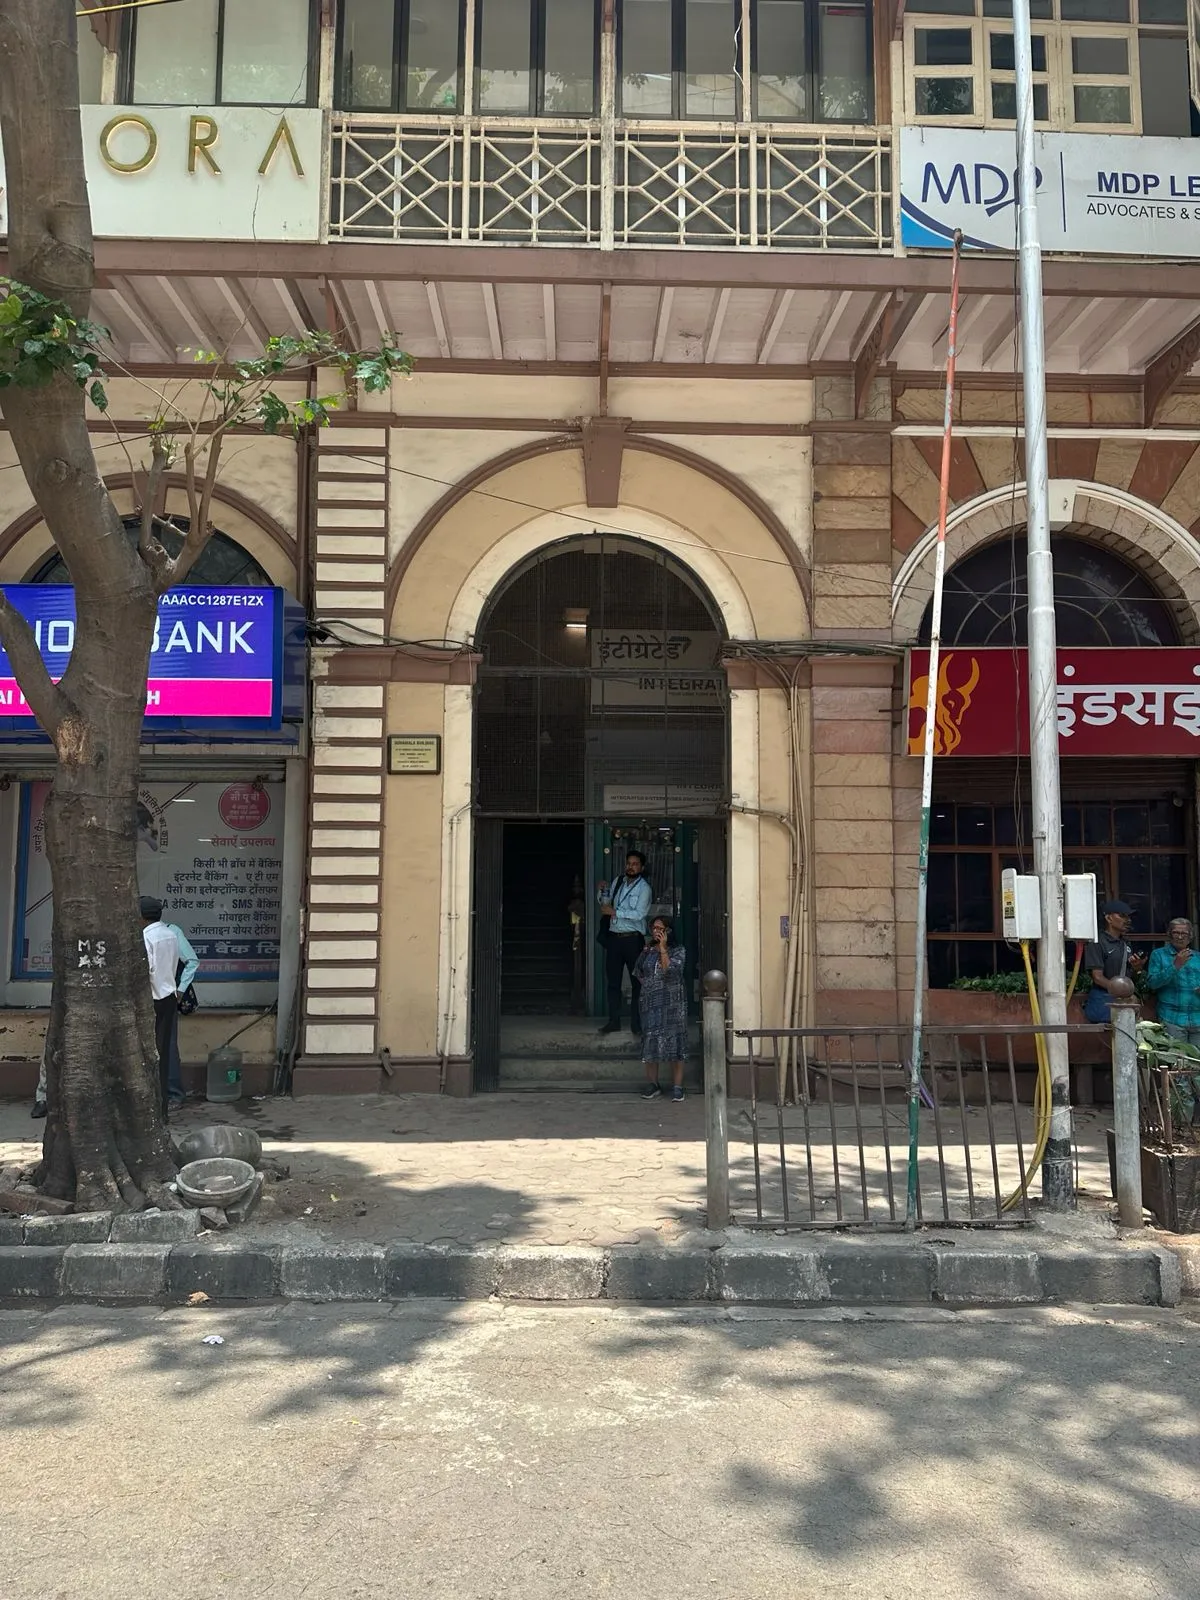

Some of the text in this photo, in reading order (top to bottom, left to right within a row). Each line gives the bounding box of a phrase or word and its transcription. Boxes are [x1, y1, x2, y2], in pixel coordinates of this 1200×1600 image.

[1097, 171, 1160, 195] MDP
[1086, 202, 1176, 219] ADVOCATES
[1180, 207, 1190, 220] &
[597, 634, 683, 663] इंटीग्रेटेड
[194, 857, 215, 868] किसी
[217, 857, 228, 868] भी
[248, 858, 257, 868] में
[174, 870, 202, 882] इंटरनेट
[186, 886, 197, 894] का
[196, 898, 214, 909] कार्ड
[232, 900, 253, 909] SMS
[218, 911, 250, 923] मोबाइल
[214, 941, 251, 954] बैंक
